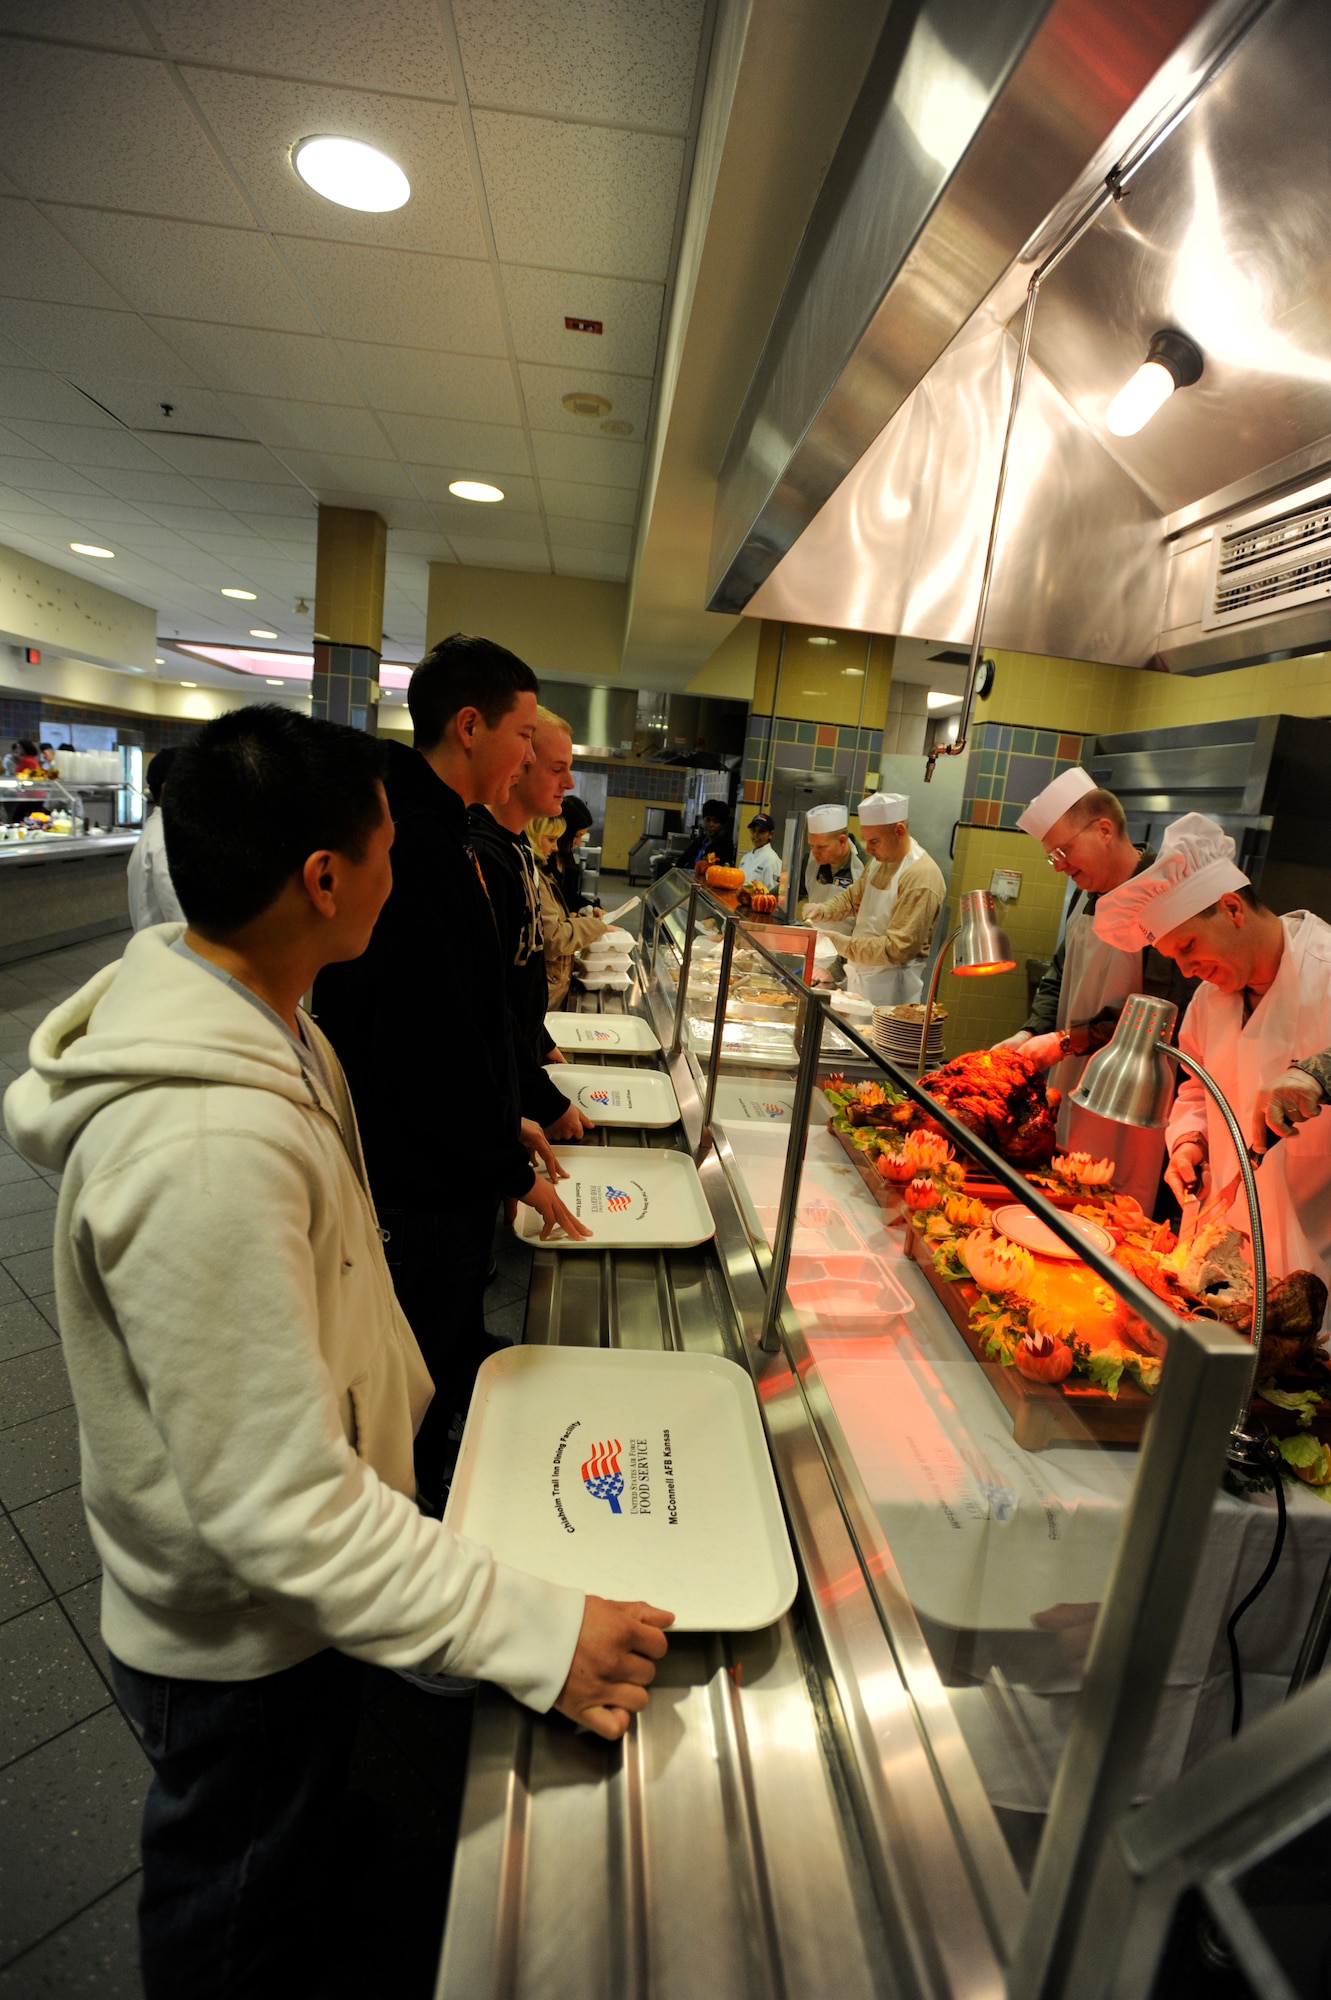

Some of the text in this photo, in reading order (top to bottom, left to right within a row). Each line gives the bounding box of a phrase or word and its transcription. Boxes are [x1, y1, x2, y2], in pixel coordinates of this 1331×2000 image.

[552, 1420, 581, 1533] Chisholm Trail Inn Dining Facility
[637, 1438, 651, 1515] FOOD SERVICE
[663, 1429, 678, 1525] McConnell AFB Kansas
